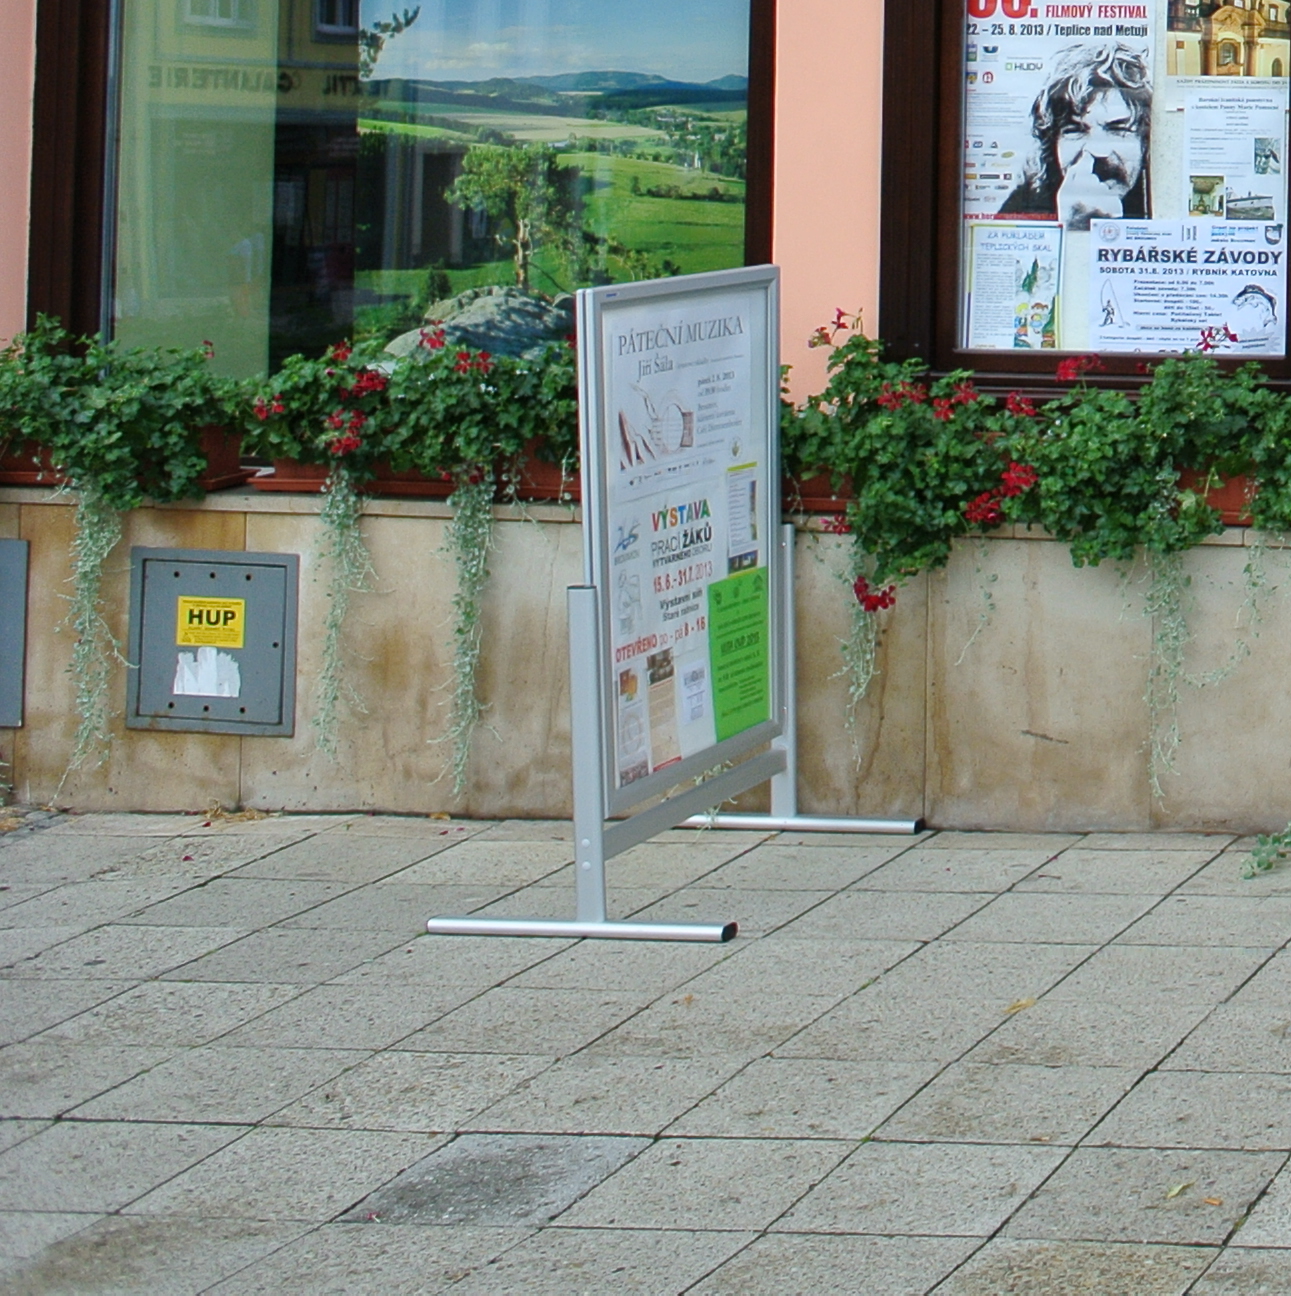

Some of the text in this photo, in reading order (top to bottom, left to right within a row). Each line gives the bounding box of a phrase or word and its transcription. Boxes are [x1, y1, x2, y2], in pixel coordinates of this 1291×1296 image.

[1045, 3, 1148, 19] FILMOVÝ FESTIVAL
[967, 23, 980, 36] 22.
[991, 23, 1007, 36] 25.
[1008, 23, 1017, 36] 8.
[1020, 23, 1044, 36] 2013
[1054, 23, 1091, 38] Teplice
[1094, 24, 1113, 36] nad
[1097, 246, 1283, 266] RYBÁŘSKÉ ZÁVODY
[1099, 267, 1136, 275] SOBOTA
[1162, 267, 1184, 275] 2013
[1192, 267, 1228, 276] RYBNÍK
[1231, 268, 1278, 276] KATOVNA
[618, 315, 744, 356] PÁTEČNÍ MUZIKA
[651, 498, 712, 533] VÝSTAVA
[651, 524, 713, 555] PRACÍ ŽÁKŮ
[188, 608, 237, 627] HUP
[615, 633, 658, 664] OTEVŘENO
